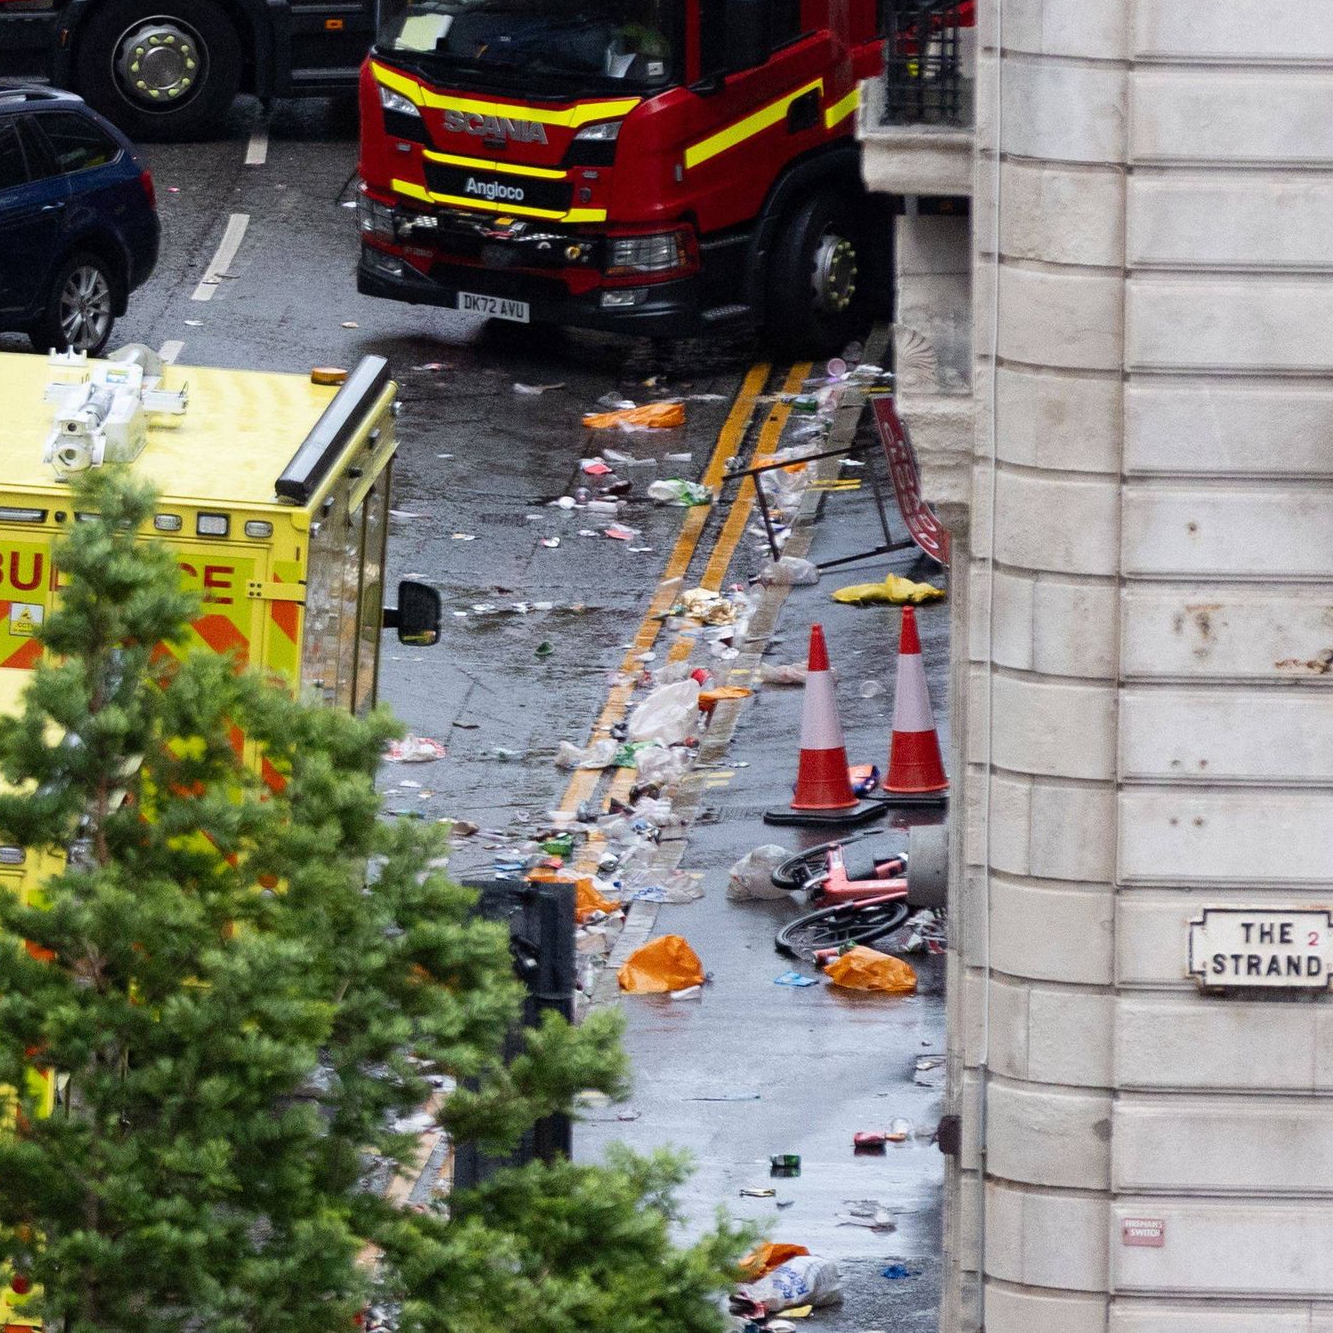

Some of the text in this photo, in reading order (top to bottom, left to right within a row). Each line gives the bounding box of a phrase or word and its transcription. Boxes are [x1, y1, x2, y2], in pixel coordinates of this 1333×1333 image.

[442, 109, 549, 145] SCANIA
[465, 177, 524, 200] Angloco
[464, 294, 524, 318] DK72 AVU
[1241, 922, 1320, 946] THE 2
[1213, 953, 1322, 976] STRAND
